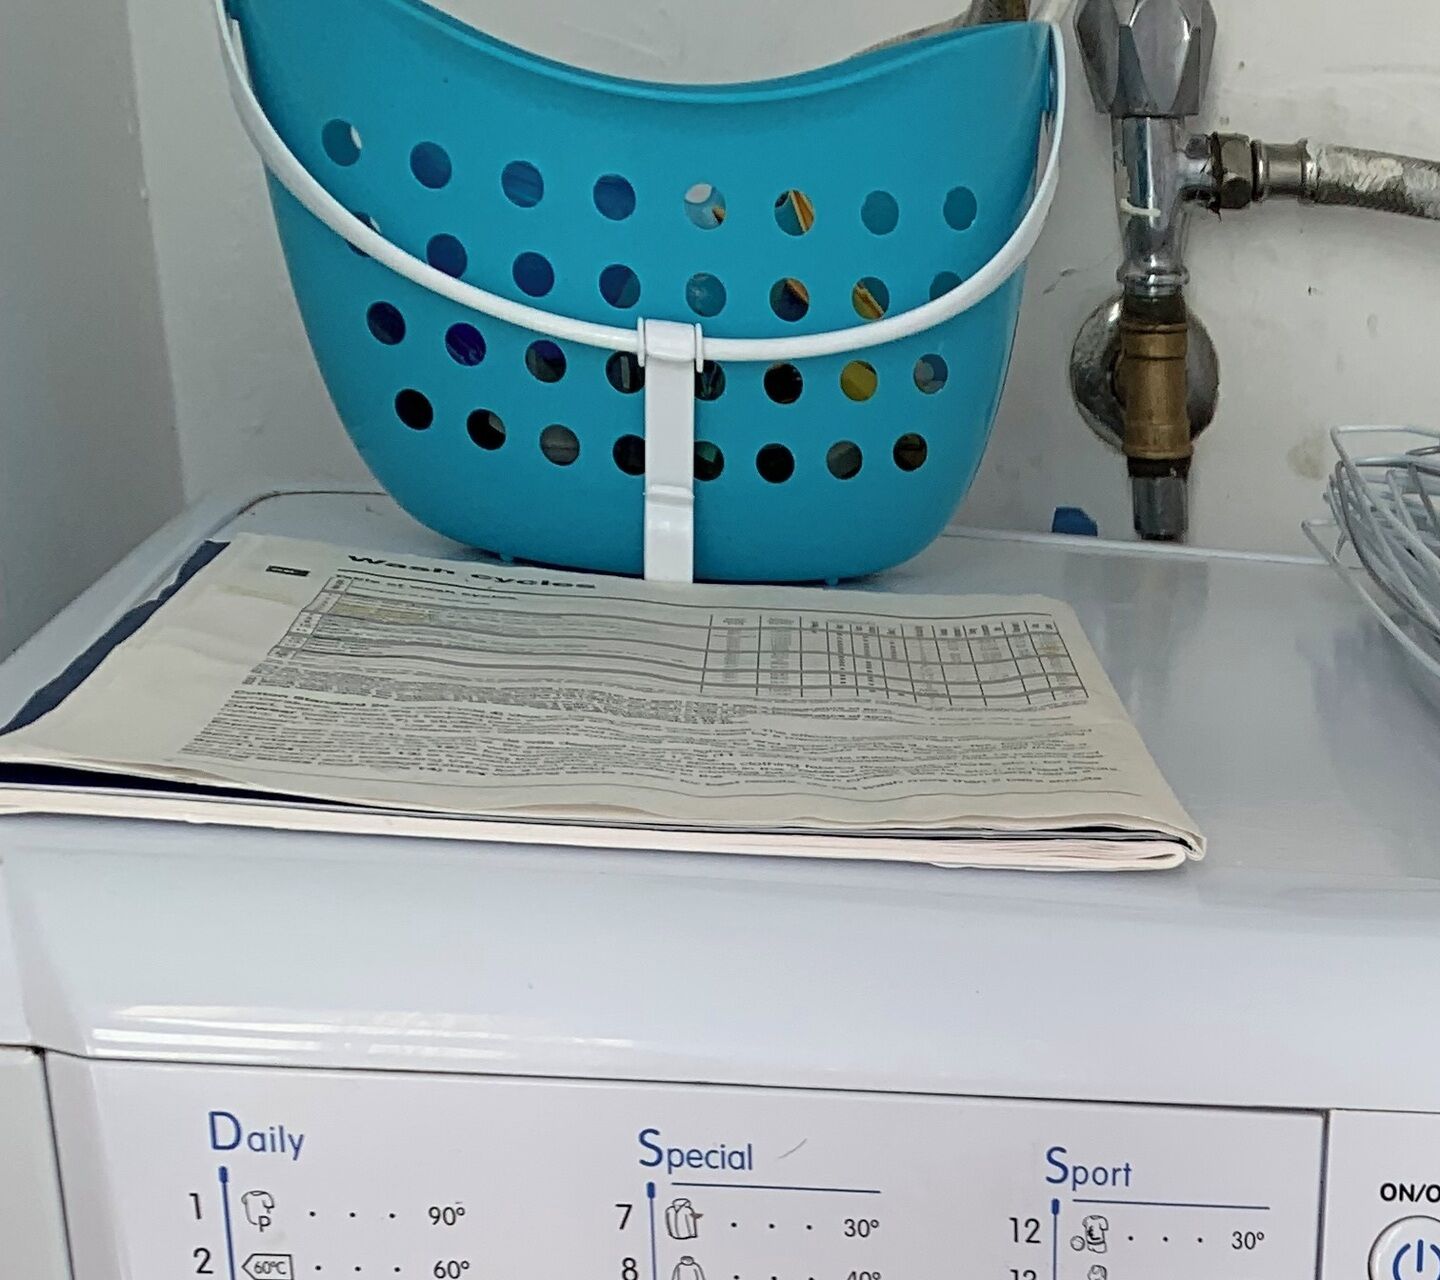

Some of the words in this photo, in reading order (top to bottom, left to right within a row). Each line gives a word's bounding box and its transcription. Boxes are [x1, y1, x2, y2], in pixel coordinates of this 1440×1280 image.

[349, 555, 455, 574] Wash
[209, 1110, 304, 1160] Daily
[638, 1128, 753, 1174] Special
[1046, 1147, 1132, 1191] Sport
[189, 1192, 202, 1219] 1
[428, 1206, 466, 1226] 90°
[616, 1204, 632, 1230] 7
[844, 1219, 880, 1238] 30°
[1009, 1217, 1041, 1244] 12
[1231, 1232, 1264, 1250] 30°
[193, 1247, 214, 1274] 2
[433, 1260, 470, 1280] 60°
